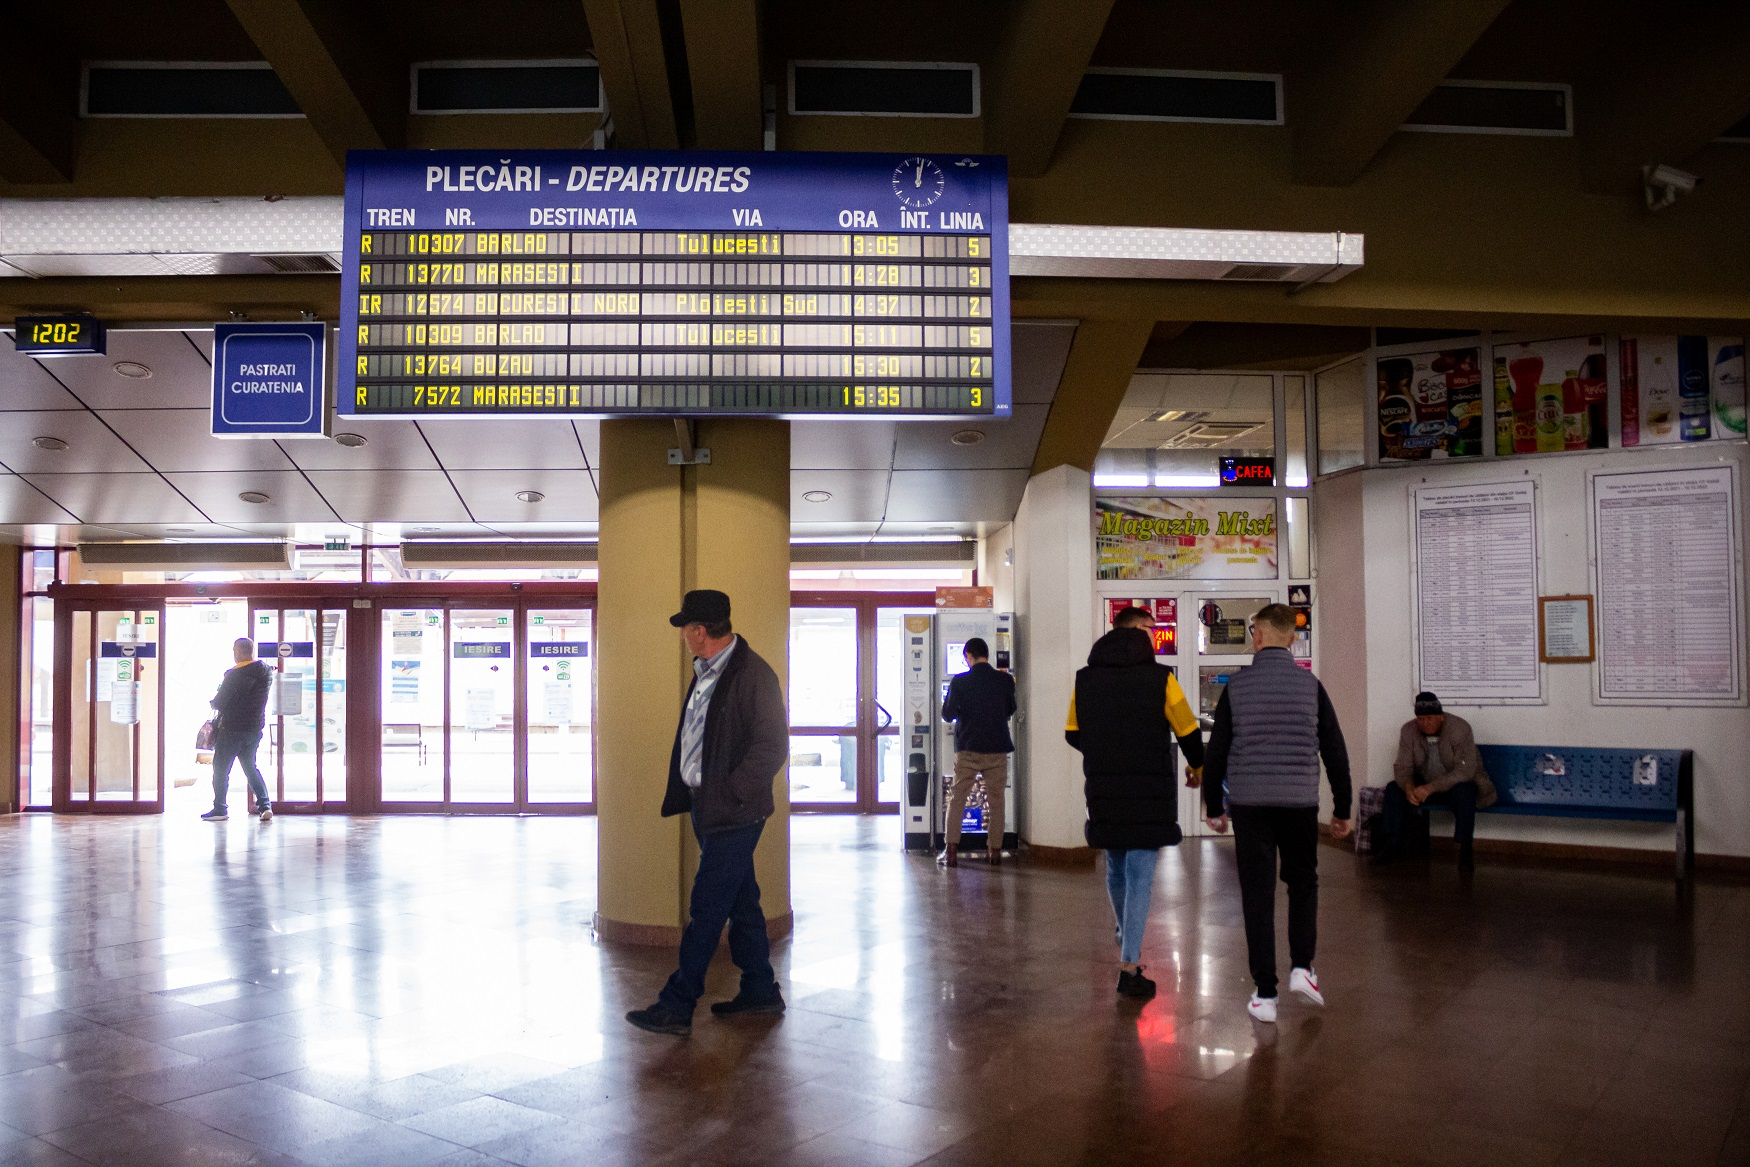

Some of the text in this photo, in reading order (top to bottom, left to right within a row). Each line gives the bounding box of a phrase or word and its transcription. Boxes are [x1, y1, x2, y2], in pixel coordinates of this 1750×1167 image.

[426, 159, 541, 191] PLECĂRI
[567, 166, 751, 191] DEPARTURES
[367, 208, 415, 225] TREN
[445, 208, 476, 225] NR.
[733, 209, 762, 226] VIA
[839, 210, 878, 227] ORA
[900, 206, 931, 229] ÎNT.
[940, 212, 983, 229] LINIA
[362, 235, 372, 252] R
[409, 235, 465, 252] 10307
[678, 235, 779, 254] Tulucesti
[842, 236, 898, 255] 13:05
[969, 237, 979, 256] 5
[361, 265, 980, 286] R 13770 MARASESTI 14:28 3
[360, 295, 381, 313] IR
[407, 295, 463, 313] 12574
[476, 295, 580, 313] BUCURESTI
[677, 296, 768, 313] Ploiesti
[784, 296, 816, 314] Sud
[842, 296, 899, 315] 14:37
[970, 297, 980, 316] 2
[358, 326, 368, 343] R
[406, 326, 463, 343] 10309
[677, 325, 779, 344] Tulucesti
[842, 326, 897, 345] 15:11
[970, 327, 980, 346] 5
[240, 364, 296, 376] PASTRATI
[357, 355, 981, 376] R 13764 BUZAU 15:30 2
[232, 382, 304, 393] CURATENIA
[357, 386, 981, 406] R 7572 MARASESTI 15:35 3
[1236, 466, 1271, 478] CAFEA
[1099, 511, 1273, 541] Magazin Mixt
[464, 646, 501, 654] IESIRE
[541, 646, 578, 654] IESIRE
